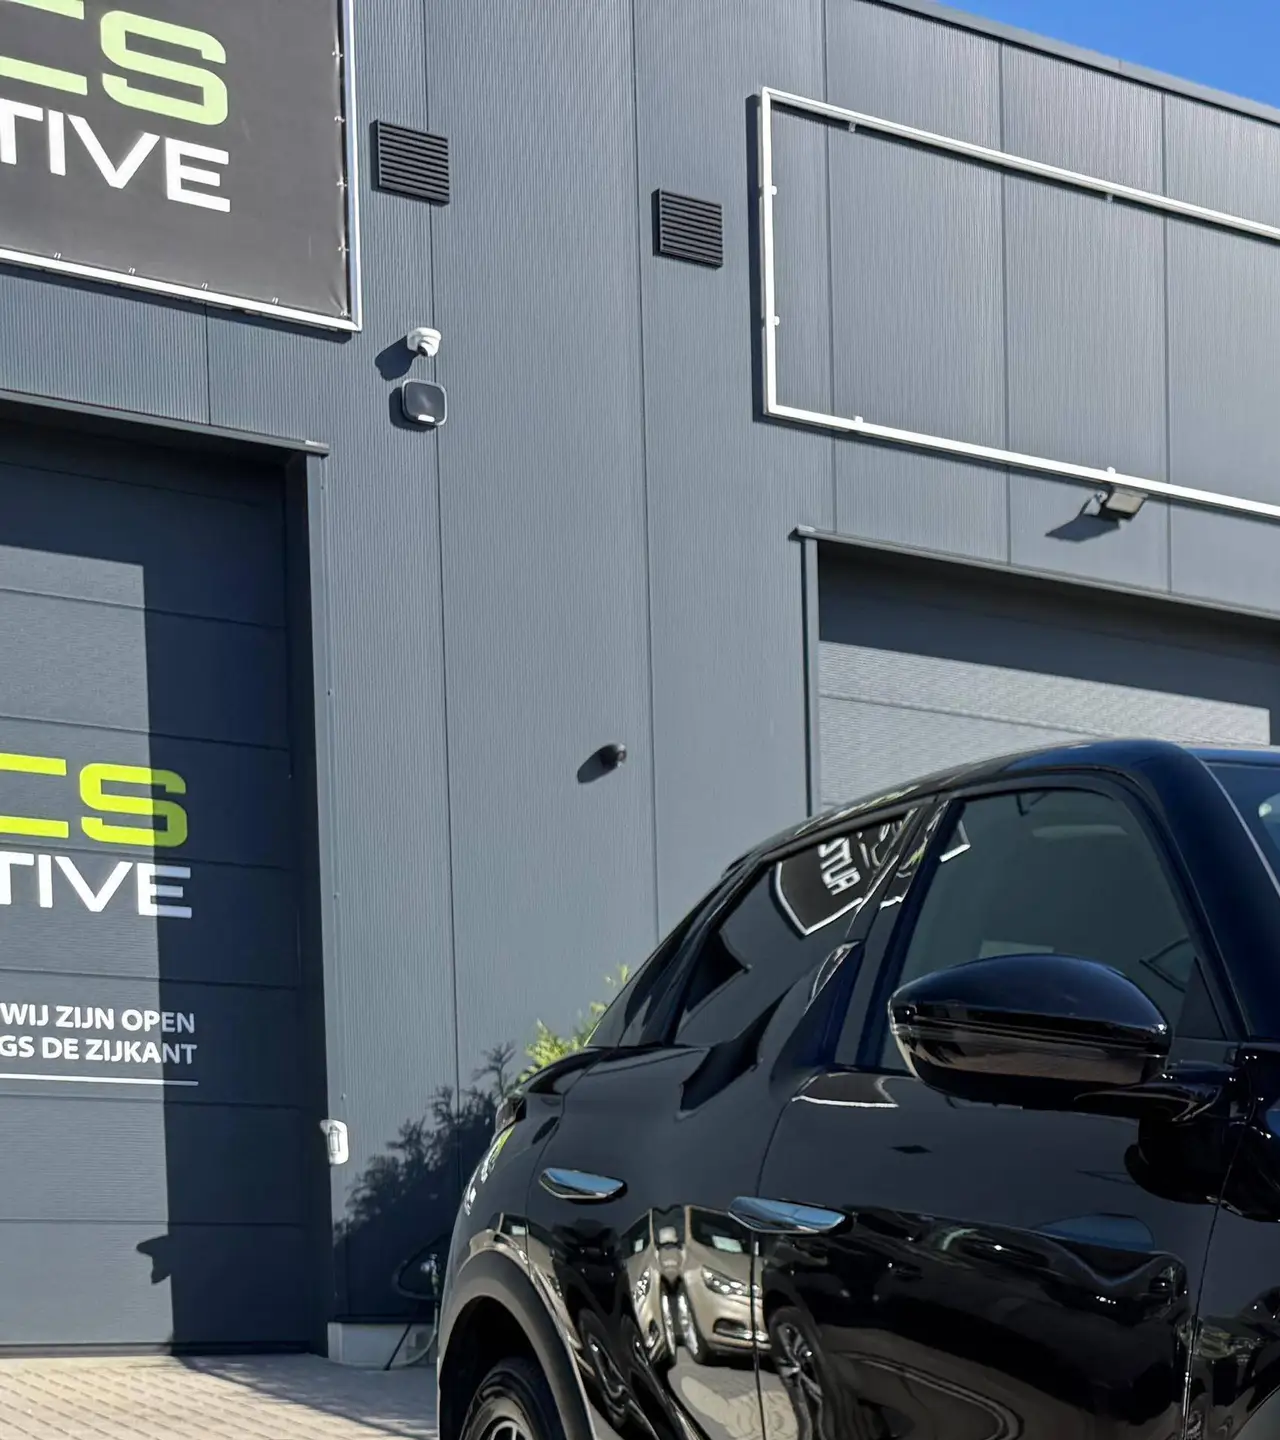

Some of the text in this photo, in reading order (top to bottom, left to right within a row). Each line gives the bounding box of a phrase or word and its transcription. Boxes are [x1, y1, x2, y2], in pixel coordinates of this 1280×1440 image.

[0, 1002, 196, 1034] WIJ ZIJN OPEN
[41, 1036, 80, 1061] DE
[86, 1038, 198, 1065] ZIJKANT
